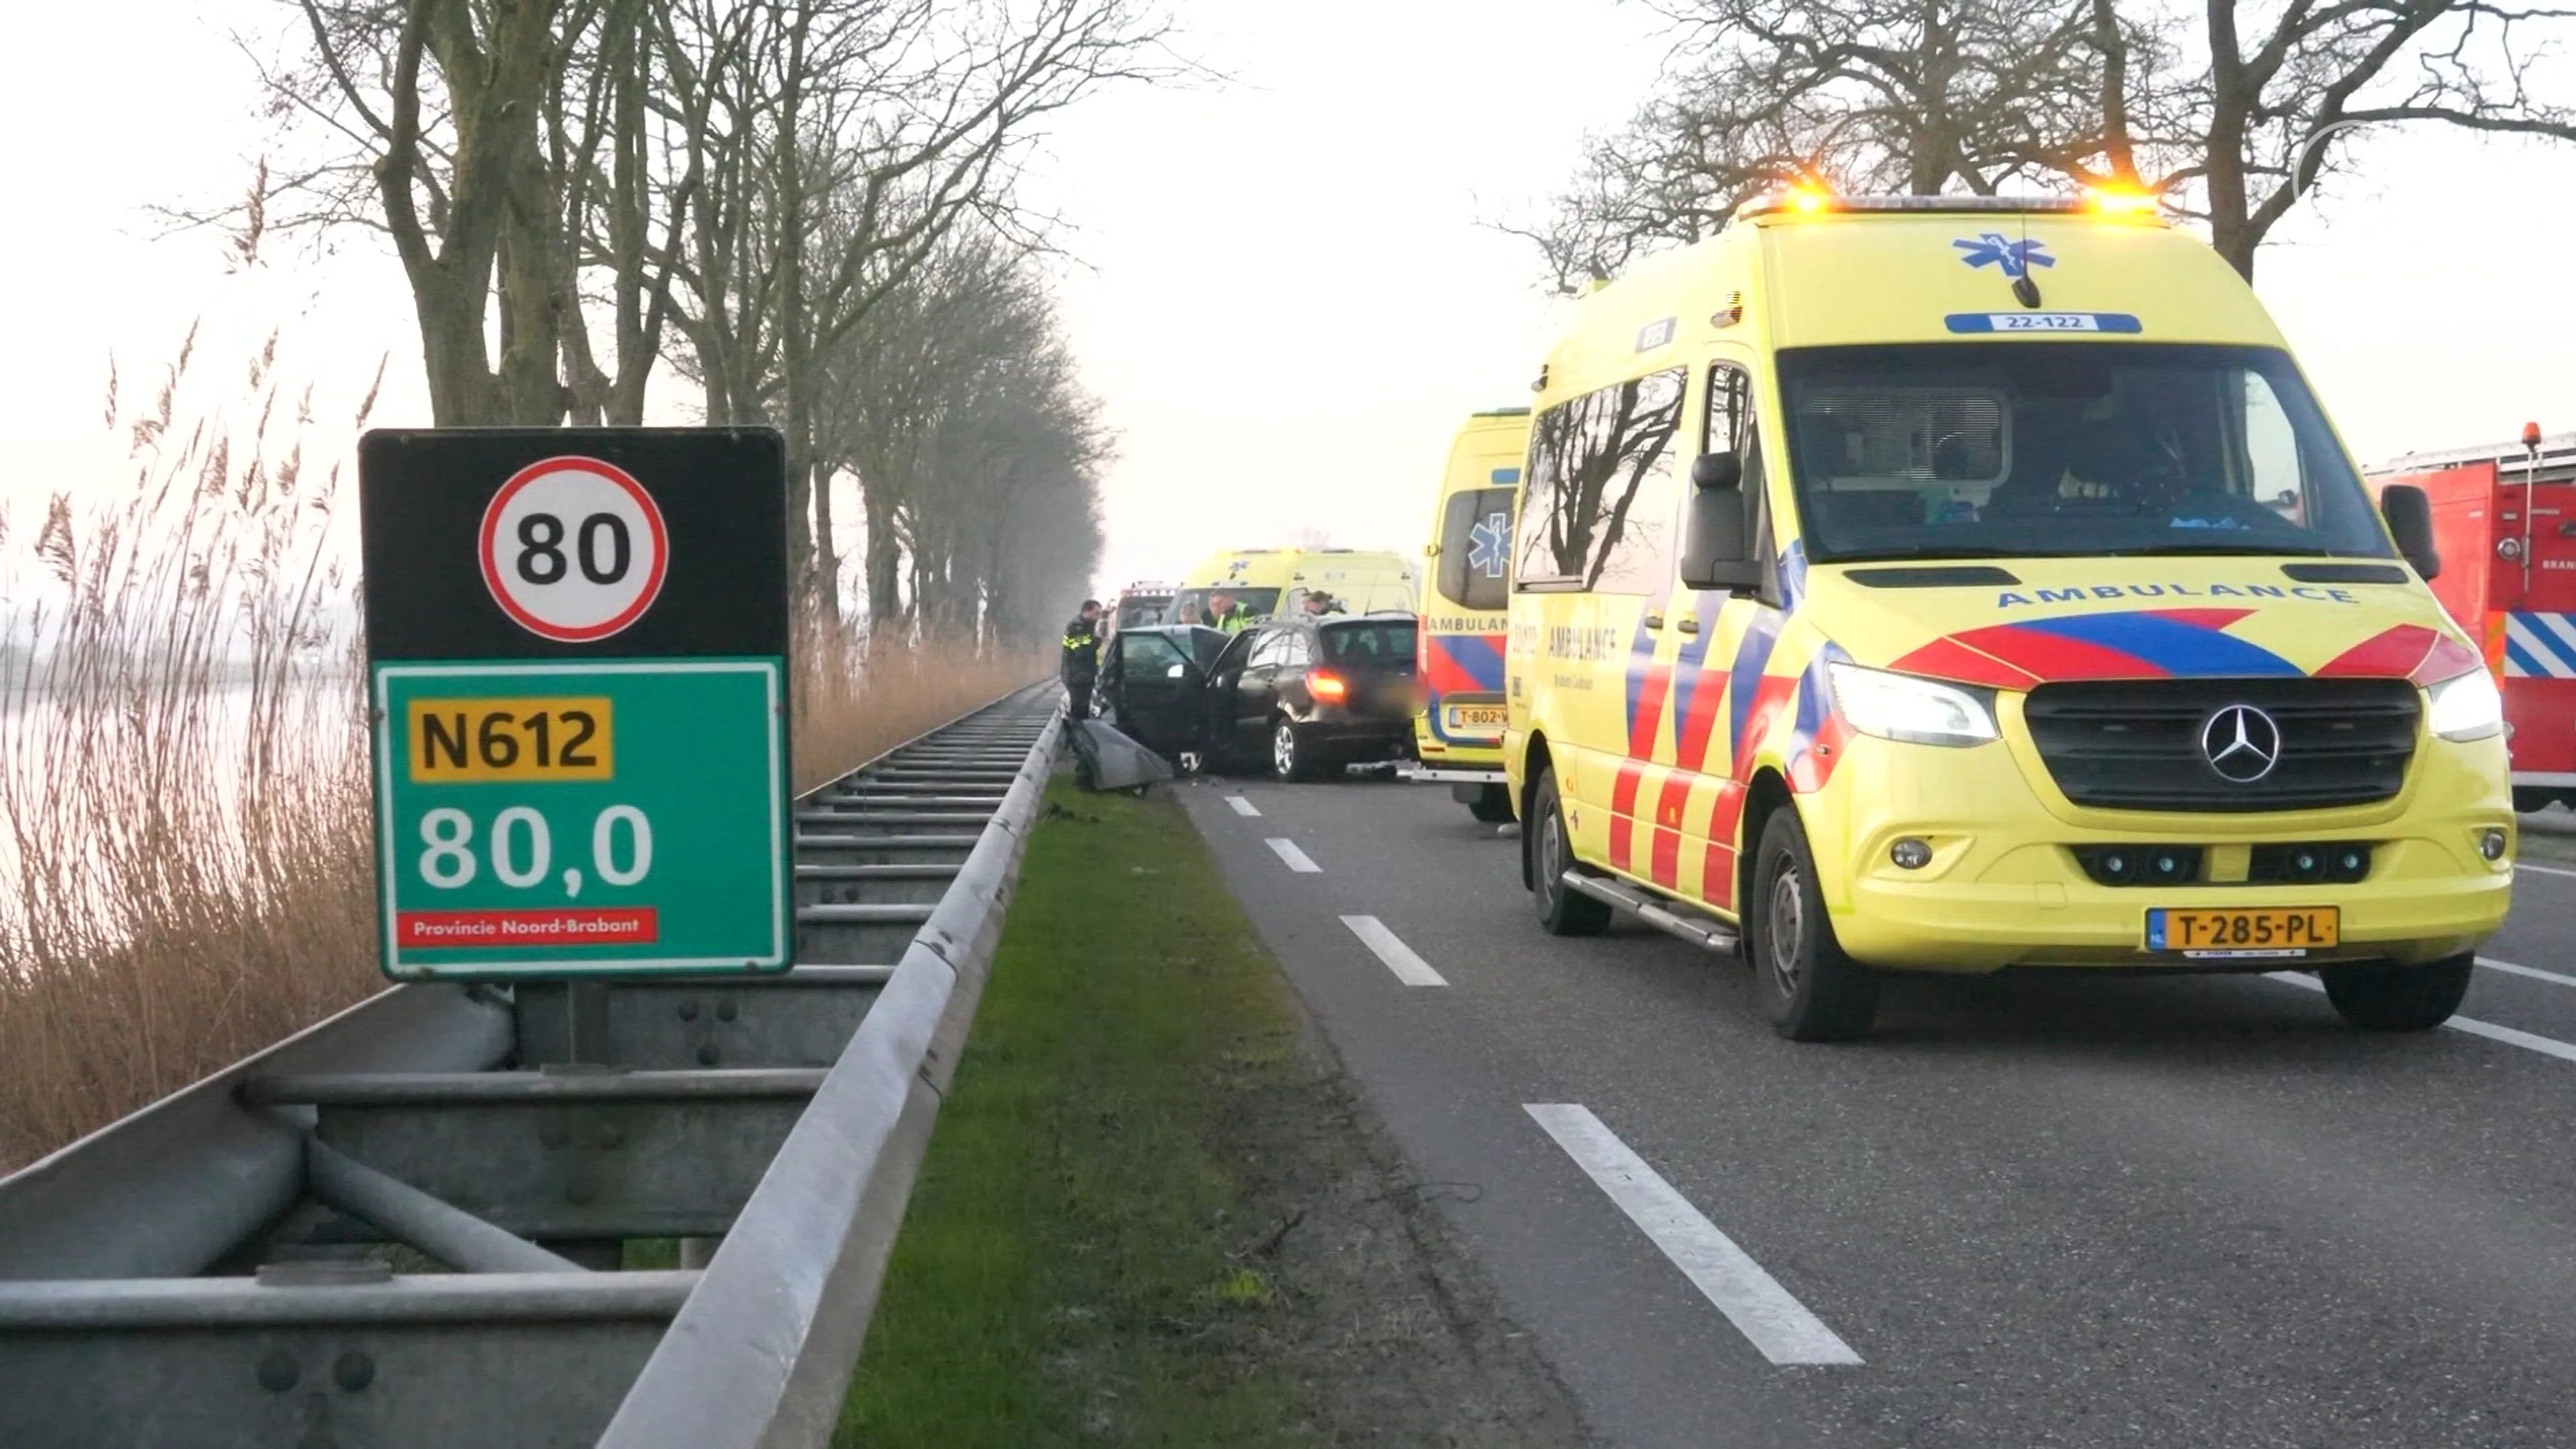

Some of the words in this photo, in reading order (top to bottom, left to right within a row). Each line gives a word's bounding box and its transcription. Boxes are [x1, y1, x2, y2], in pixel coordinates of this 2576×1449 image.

[2006, 317, 2084, 327] 22-122
[515, 513, 631, 586] 80
[2542, 559, 2576, 570] BRAN
[1998, 584, 2361, 607] AMBULANCE
[1429, 618, 1508, 631] AMBULAN
[1460, 711, 1508, 723] T-802-V
[421, 711, 597, 769] N612
[419, 804, 653, 898] 80,0
[414, 920, 496, 936] Provincie
[502, 918, 639, 934] Noord-Brabant
[2178, 914, 2324, 945] T-285-PL
